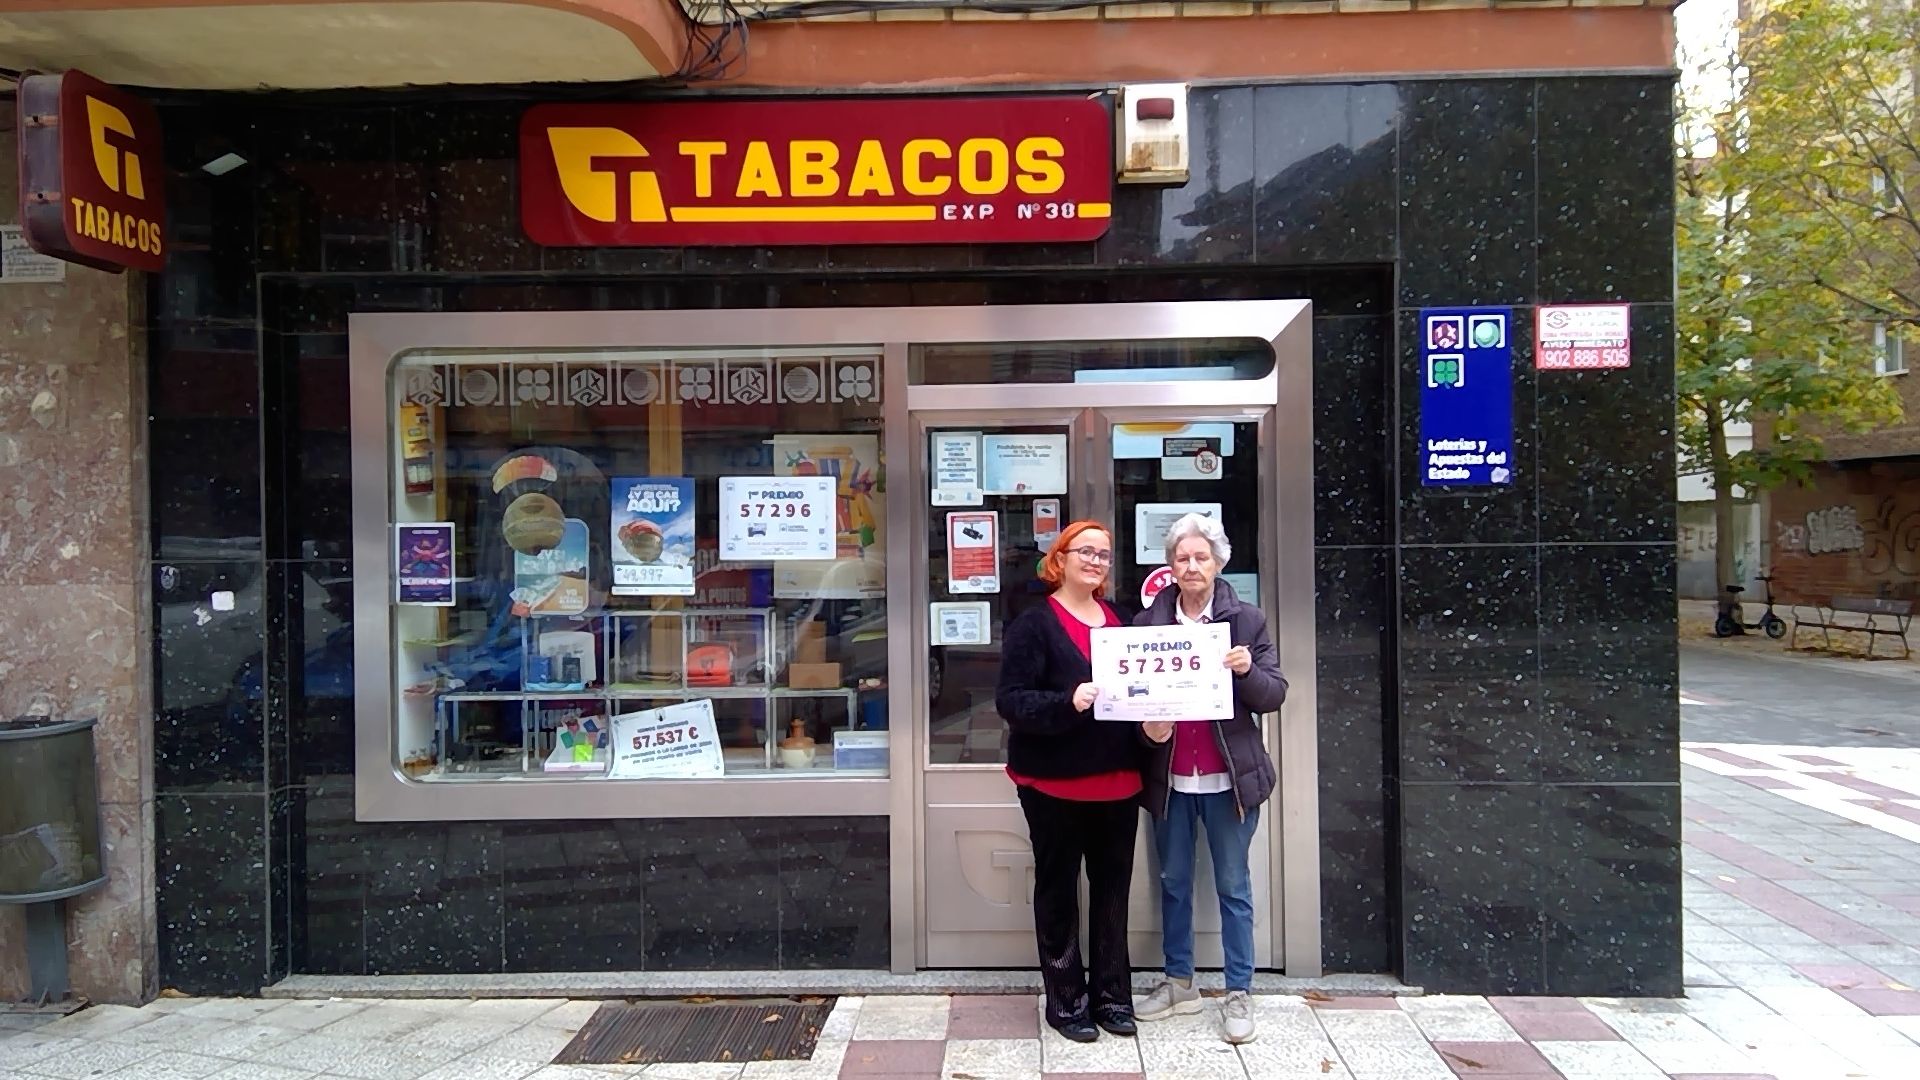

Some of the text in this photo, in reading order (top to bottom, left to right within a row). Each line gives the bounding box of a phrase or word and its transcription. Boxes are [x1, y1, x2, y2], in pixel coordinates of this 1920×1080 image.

[678, 136, 1065, 198] TABACOS
[1045, 202, 1076, 219] 38
[72, 196, 162, 256] TABACOS
[1545, 348, 1628, 367] 902 886 505
[1429, 467, 1470, 479] Estado
[762, 490, 804, 500] PREMIO
[740, 503, 811, 518] 57296
[1143, 641, 1192, 652] PREMIO
[1118, 656, 1201, 675] 57296
[633, 726, 699, 750] 57.537 €
